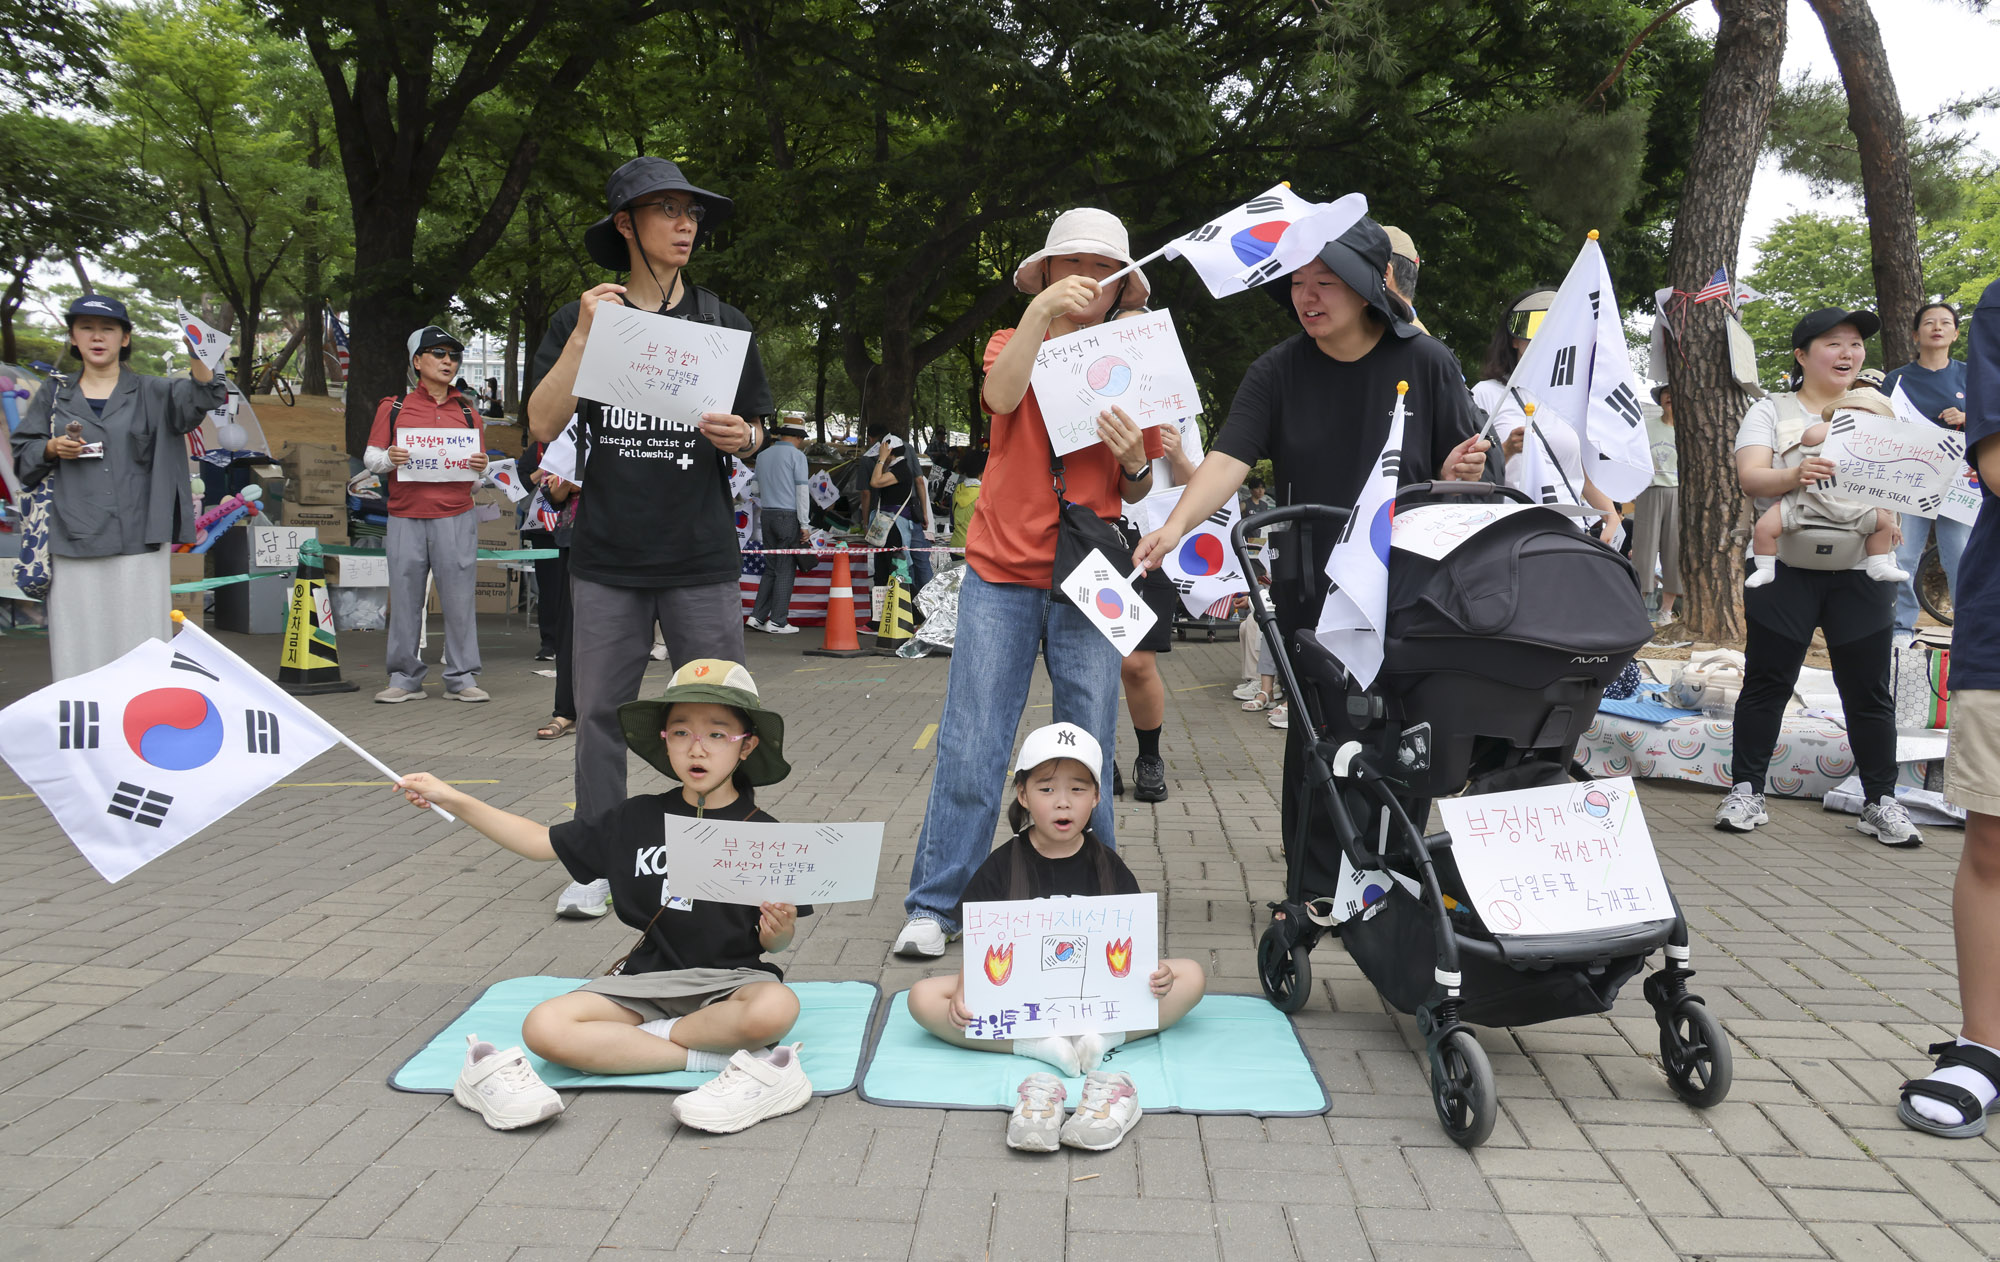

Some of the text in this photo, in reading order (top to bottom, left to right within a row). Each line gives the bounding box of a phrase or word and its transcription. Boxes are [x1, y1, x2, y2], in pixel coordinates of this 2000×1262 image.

[640, 342, 699, 366] 부정선거
[1036, 321, 1168, 369] 부정선거 재선거
[629, 361, 699, 386] 재선거 당일투표
[644, 378, 682, 396] 수개표
[1139, 394, 1187, 418] 수개표
[405, 434, 474, 448] 부정선거 재선거
[600, 436, 696, 448] Disciple Christ of
[1850, 430, 1945, 463] 부정선거 재선거
[619, 449, 674, 460] Fellowship
[1892, 470, 1926, 488] 수개표
[1843, 481, 1913, 505] STOP THE STEAL
[290, 519, 320, 527] coupang
[262, 531, 300, 553] 담요
[884, 590, 894, 634] 주차금지
[288, 600, 302, 663] 주차금지
[1057, 730, 1076, 746] NY
[1466, 805, 1565, 847] 부정선거
[721, 838, 808, 859] 부정선거
[1551, 837, 1622, 863] 재선거!
[713, 859, 816, 874] 재선거 당일투표
[729, 873, 796, 886] 수개표
[1500, 873, 1578, 901] 당일투표
